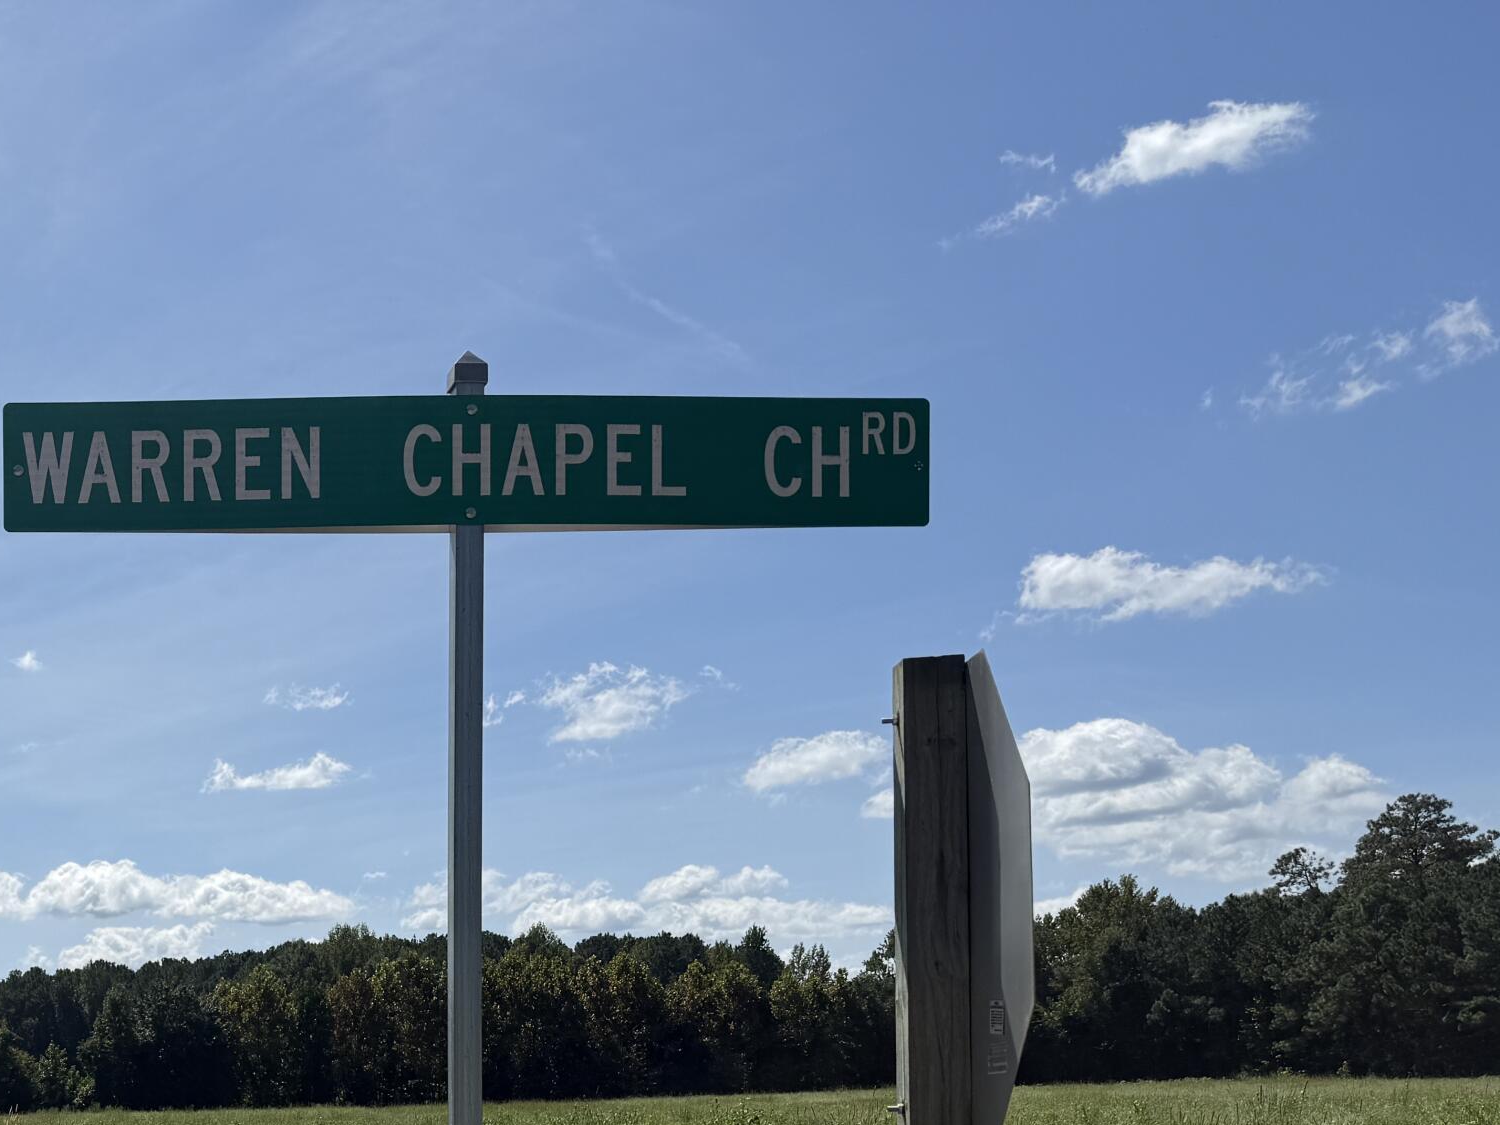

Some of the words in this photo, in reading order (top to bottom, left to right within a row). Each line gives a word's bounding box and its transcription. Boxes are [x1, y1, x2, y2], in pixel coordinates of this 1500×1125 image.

[22, 425, 321, 504] WARREN
[402, 423, 687, 498] CHAPEL
[763, 425, 850, 498] CH
[861, 411, 917, 455] RD
